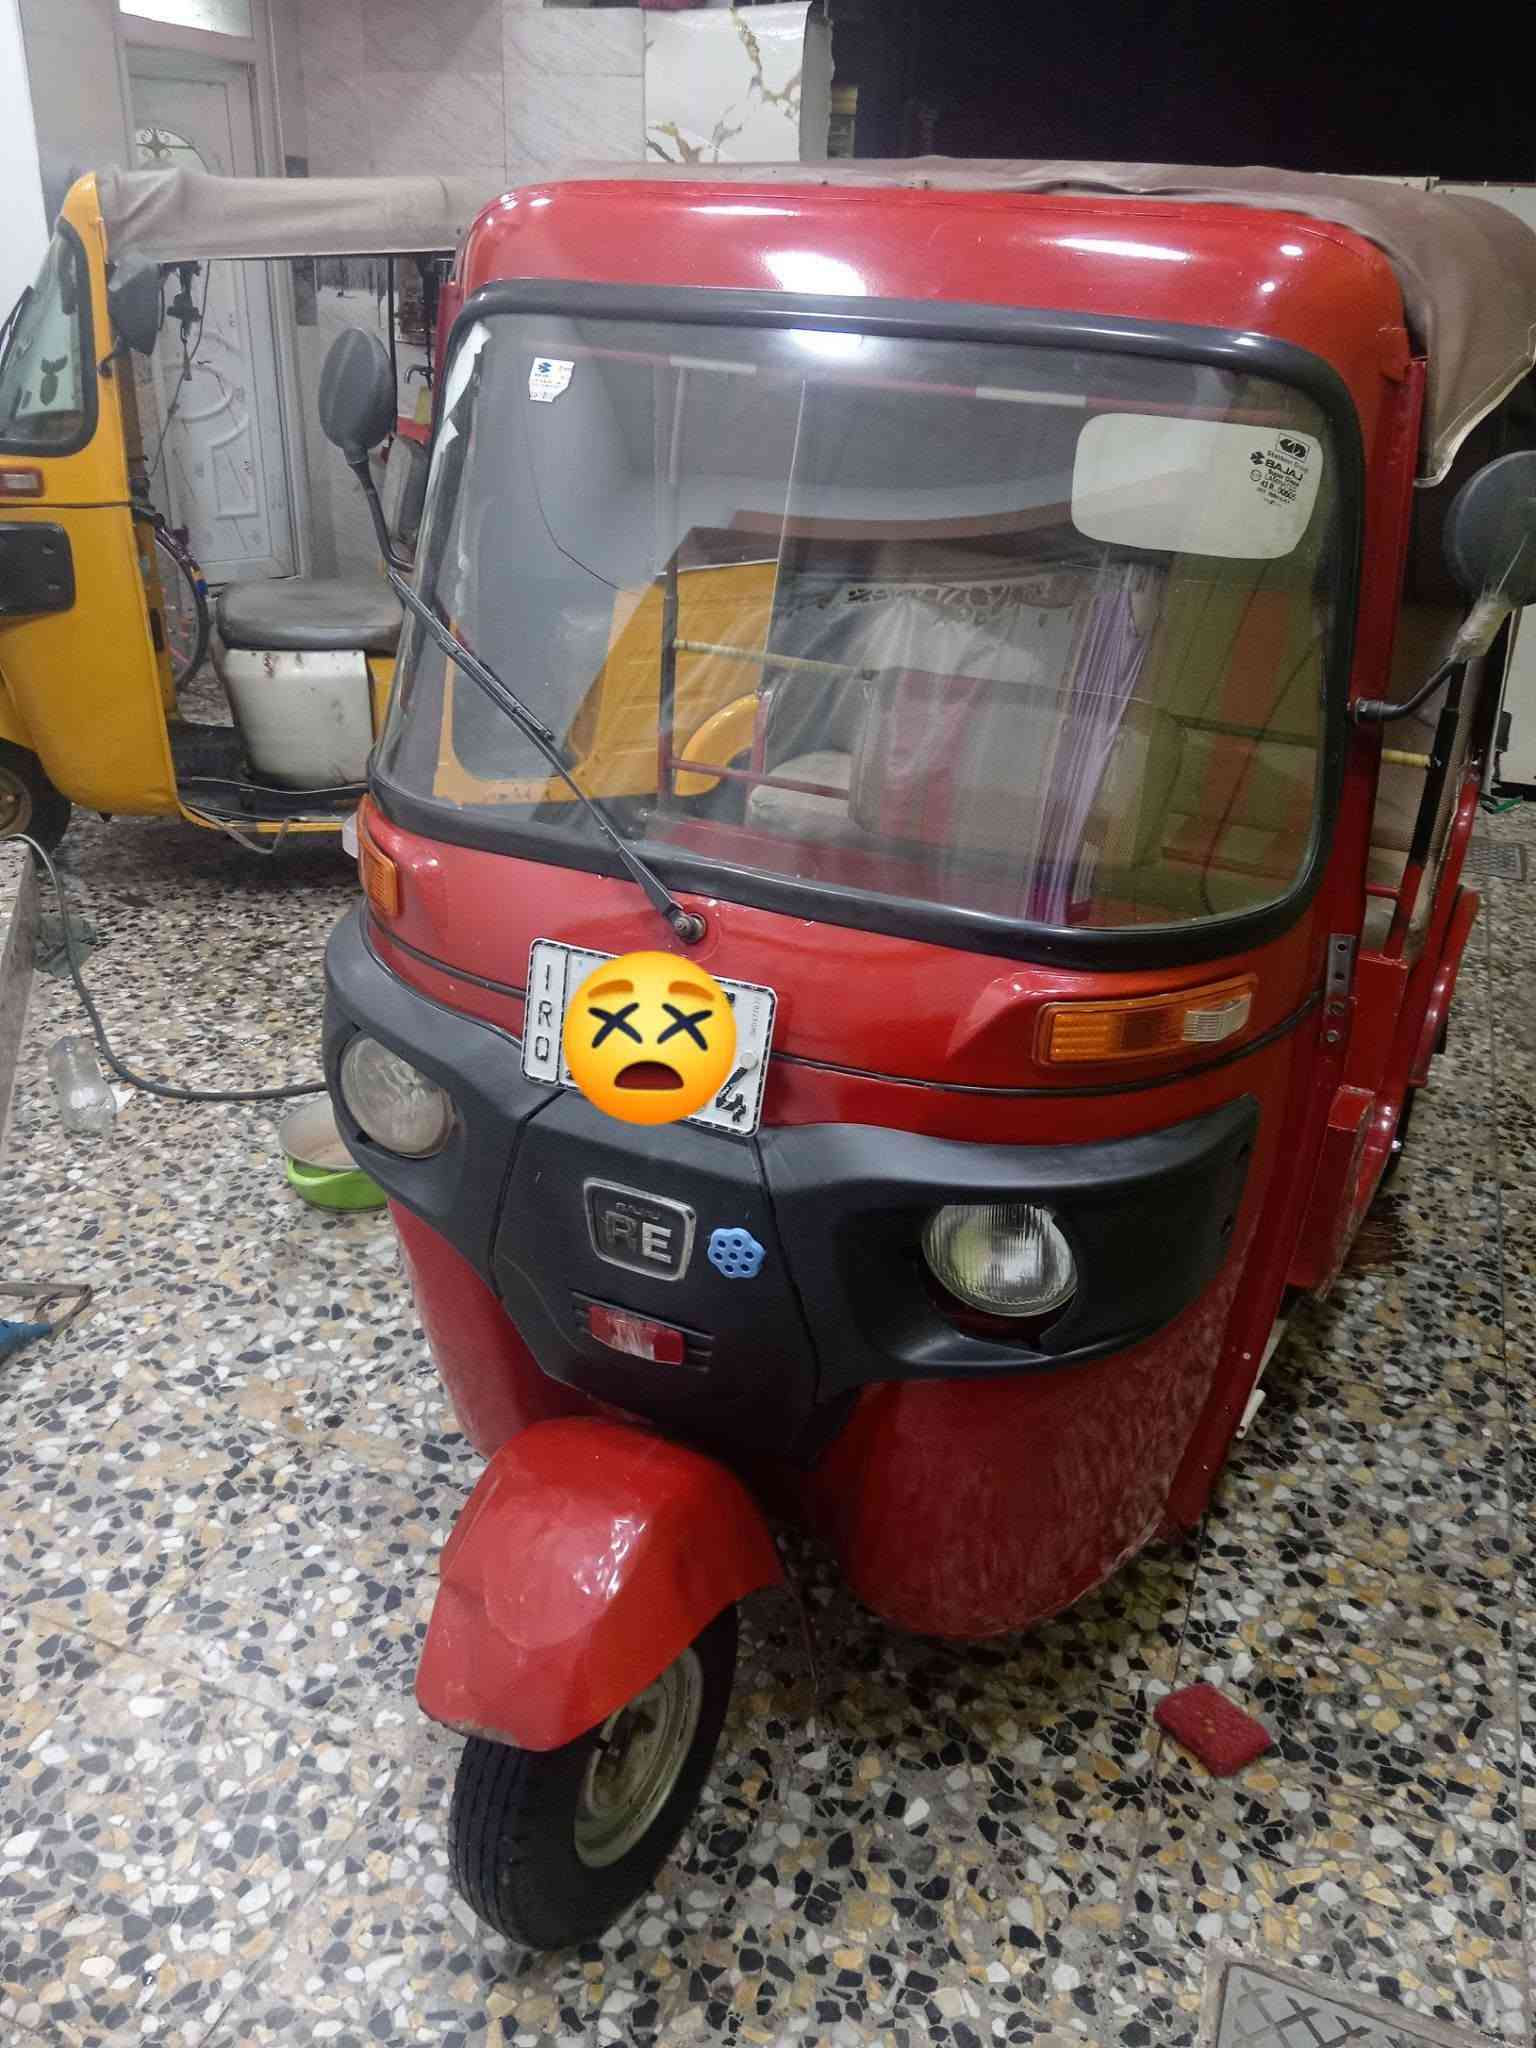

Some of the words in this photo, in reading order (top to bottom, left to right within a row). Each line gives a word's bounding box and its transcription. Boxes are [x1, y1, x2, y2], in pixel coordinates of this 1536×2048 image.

[1265, 459, 1303, 481] BAJAJ
[535, 964, 552, 1062] IRQ
[605, 1210, 672, 1264] RE
